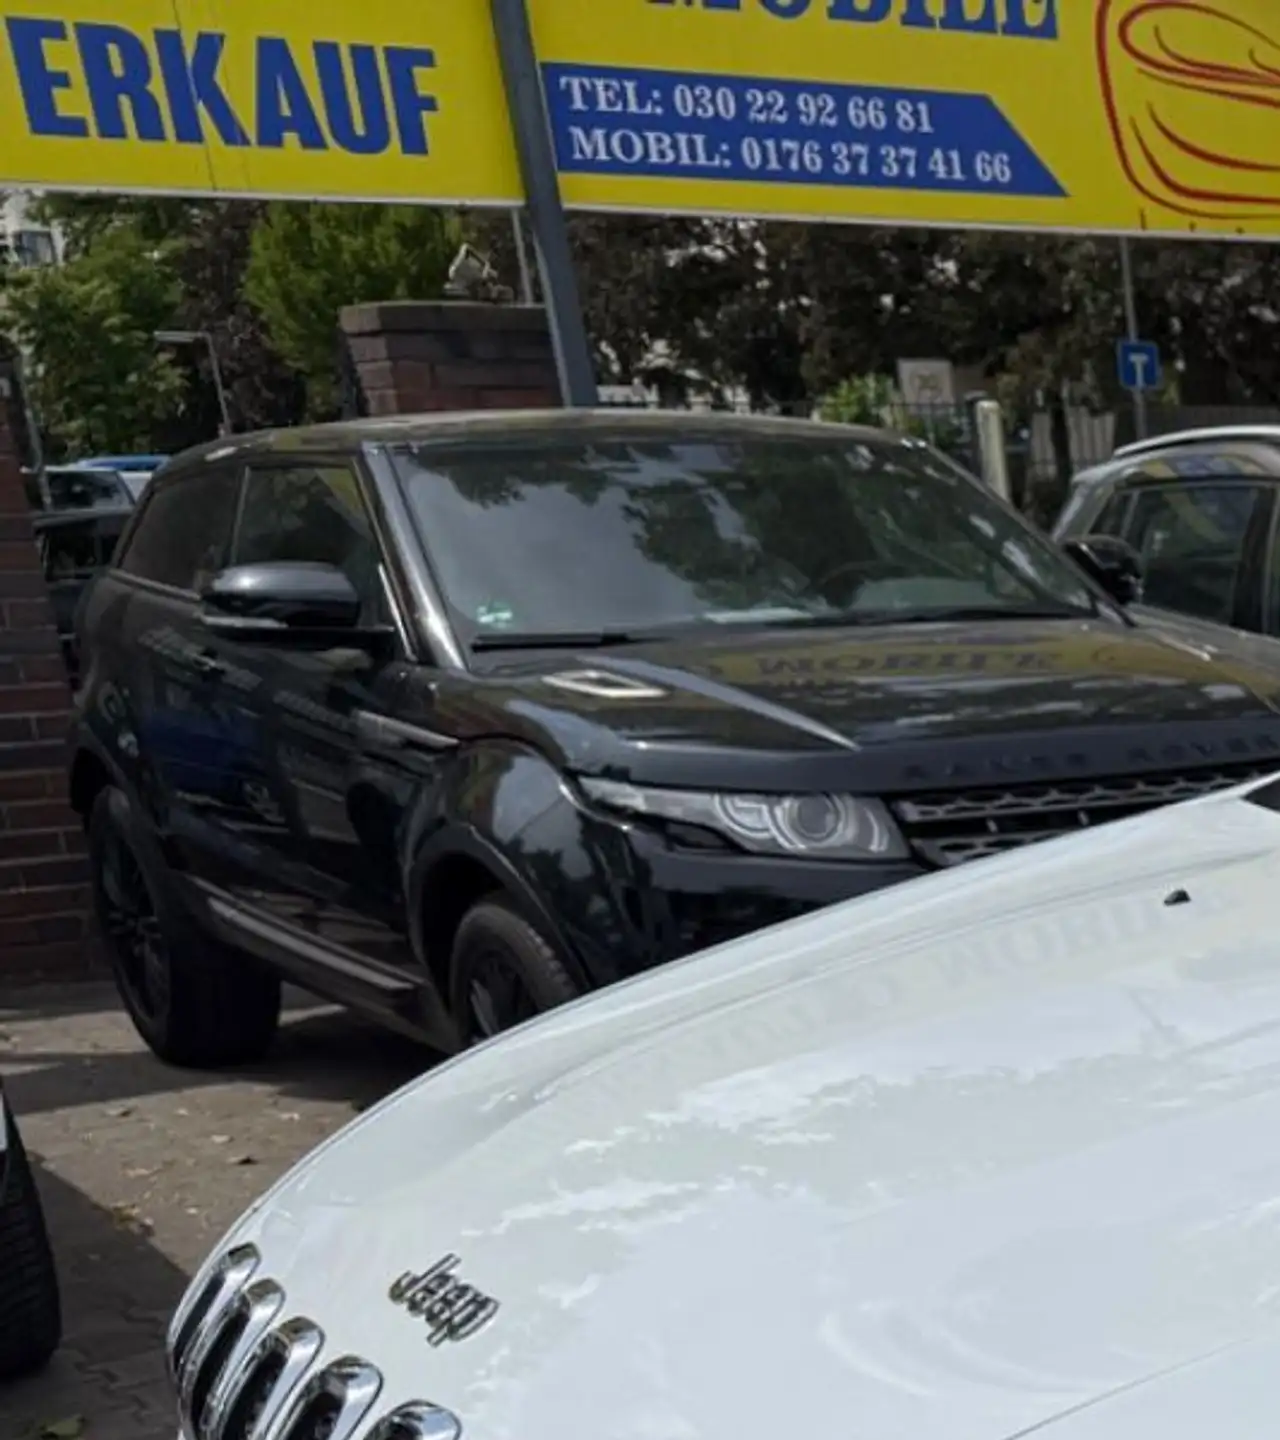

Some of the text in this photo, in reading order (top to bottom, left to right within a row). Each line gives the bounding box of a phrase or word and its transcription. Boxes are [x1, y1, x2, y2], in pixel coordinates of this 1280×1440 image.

[4, 16, 438, 156] ERKAUF
[559, 75, 935, 134] TEL: 030 22 92 66 81
[568, 125, 1013, 183] MOBIL: 0176 37 37 41 66
[388, 1253, 501, 1348] Jeep
